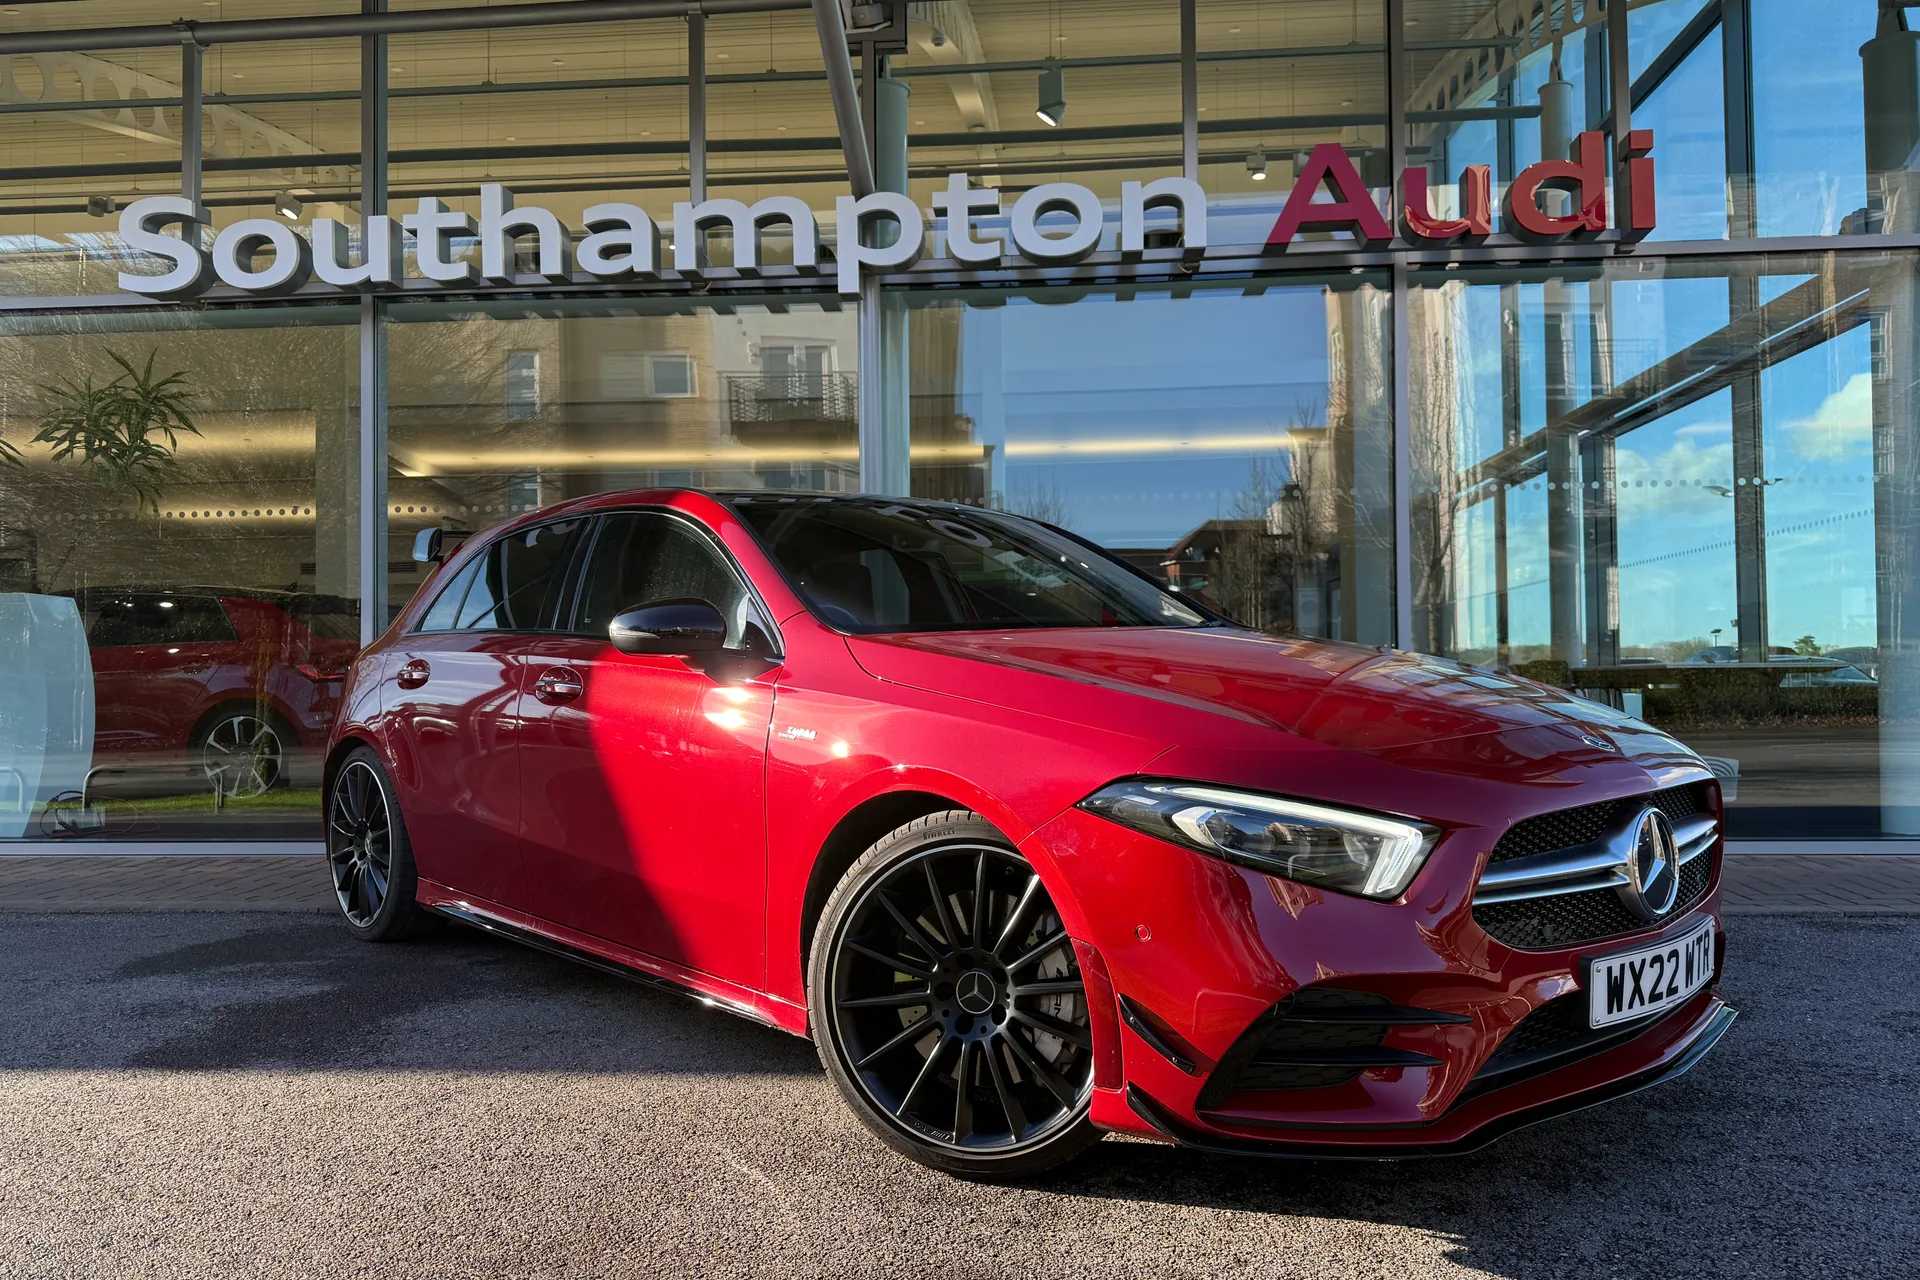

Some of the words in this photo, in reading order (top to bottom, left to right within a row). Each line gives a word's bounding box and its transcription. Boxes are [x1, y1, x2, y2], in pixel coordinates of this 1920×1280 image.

[118, 173, 1208, 297] Southampton
[1266, 129, 1655, 249] Audi
[1607, 949, 1680, 1014] WX22
[1685, 930, 1709, 988] WTR
